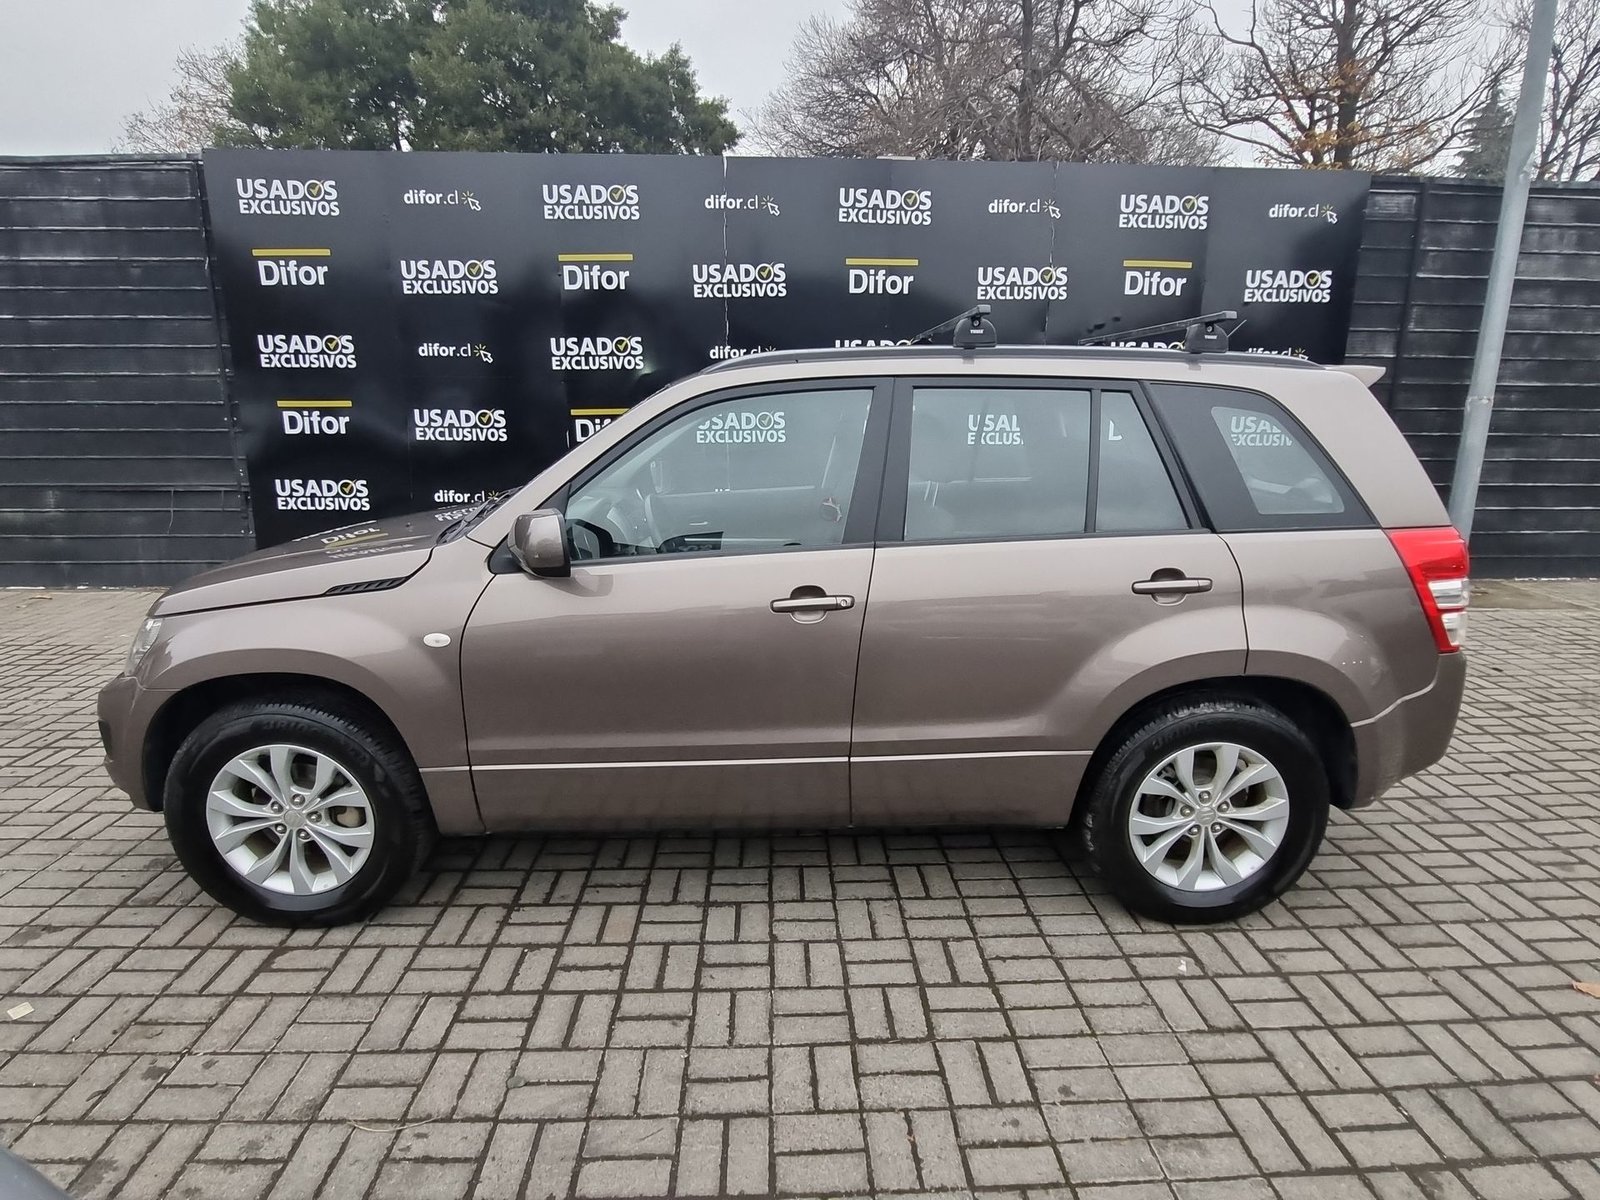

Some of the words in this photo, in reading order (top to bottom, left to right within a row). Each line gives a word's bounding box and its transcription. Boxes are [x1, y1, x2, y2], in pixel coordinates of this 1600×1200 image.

[236, 178, 338, 201] USADOS
[403, 189, 459, 205] difor.cl
[543, 184, 639, 205] USADOS
[839, 187, 932, 209] USADOS
[239, 199, 340, 217] EXCLUSIVOS
[704, 195, 759, 210] difor.cl
[988, 199, 1041, 214] difor.cl
[1120, 194, 1209, 216] USADOS
[1268, 204, 1319, 219] difor.cl
[544, 205, 640, 221] EXCLUSIVOS
[838, 208, 932, 226] EXCLUSIVOS
[1118, 214, 1208, 231] EXCLUSIVOS
[257, 260, 329, 287] Difor
[400, 259, 497, 281] USADOS
[562, 265, 630, 291] Difor
[692, 263, 786, 283] USADOS
[977, 266, 1068, 287] USADOS
[402, 279, 499, 295] EXCLUSIVOS
[849, 269, 914, 295] Difor
[1124, 271, 1187, 297] Difor
[1245, 270, 1333, 290] USADOS
[693, 283, 787, 299] EXCLUSIVOS
[977, 286, 1068, 301] EXCLUSIVOS
[1243, 288, 1332, 304] EXCLUSIVOS
[257, 334, 355, 355] USADOS
[418, 342, 472, 358] difor.cl
[550, 336, 644, 356] USADOS
[260, 353, 357, 369] EXCLUSIVOS
[551, 355, 644, 371] EXCLUSIVOS
[282, 410, 350, 435] Difor
[413, 408, 507, 428] USADOS
[415, 427, 508, 442] EXCLUSIVOS
[696, 430, 786, 444] EXCLUSIVOS
[274, 478, 369, 498] USADOS
[434, 489, 486, 504] difor.cl
[277, 497, 371, 511] EXCLUSIVOS
